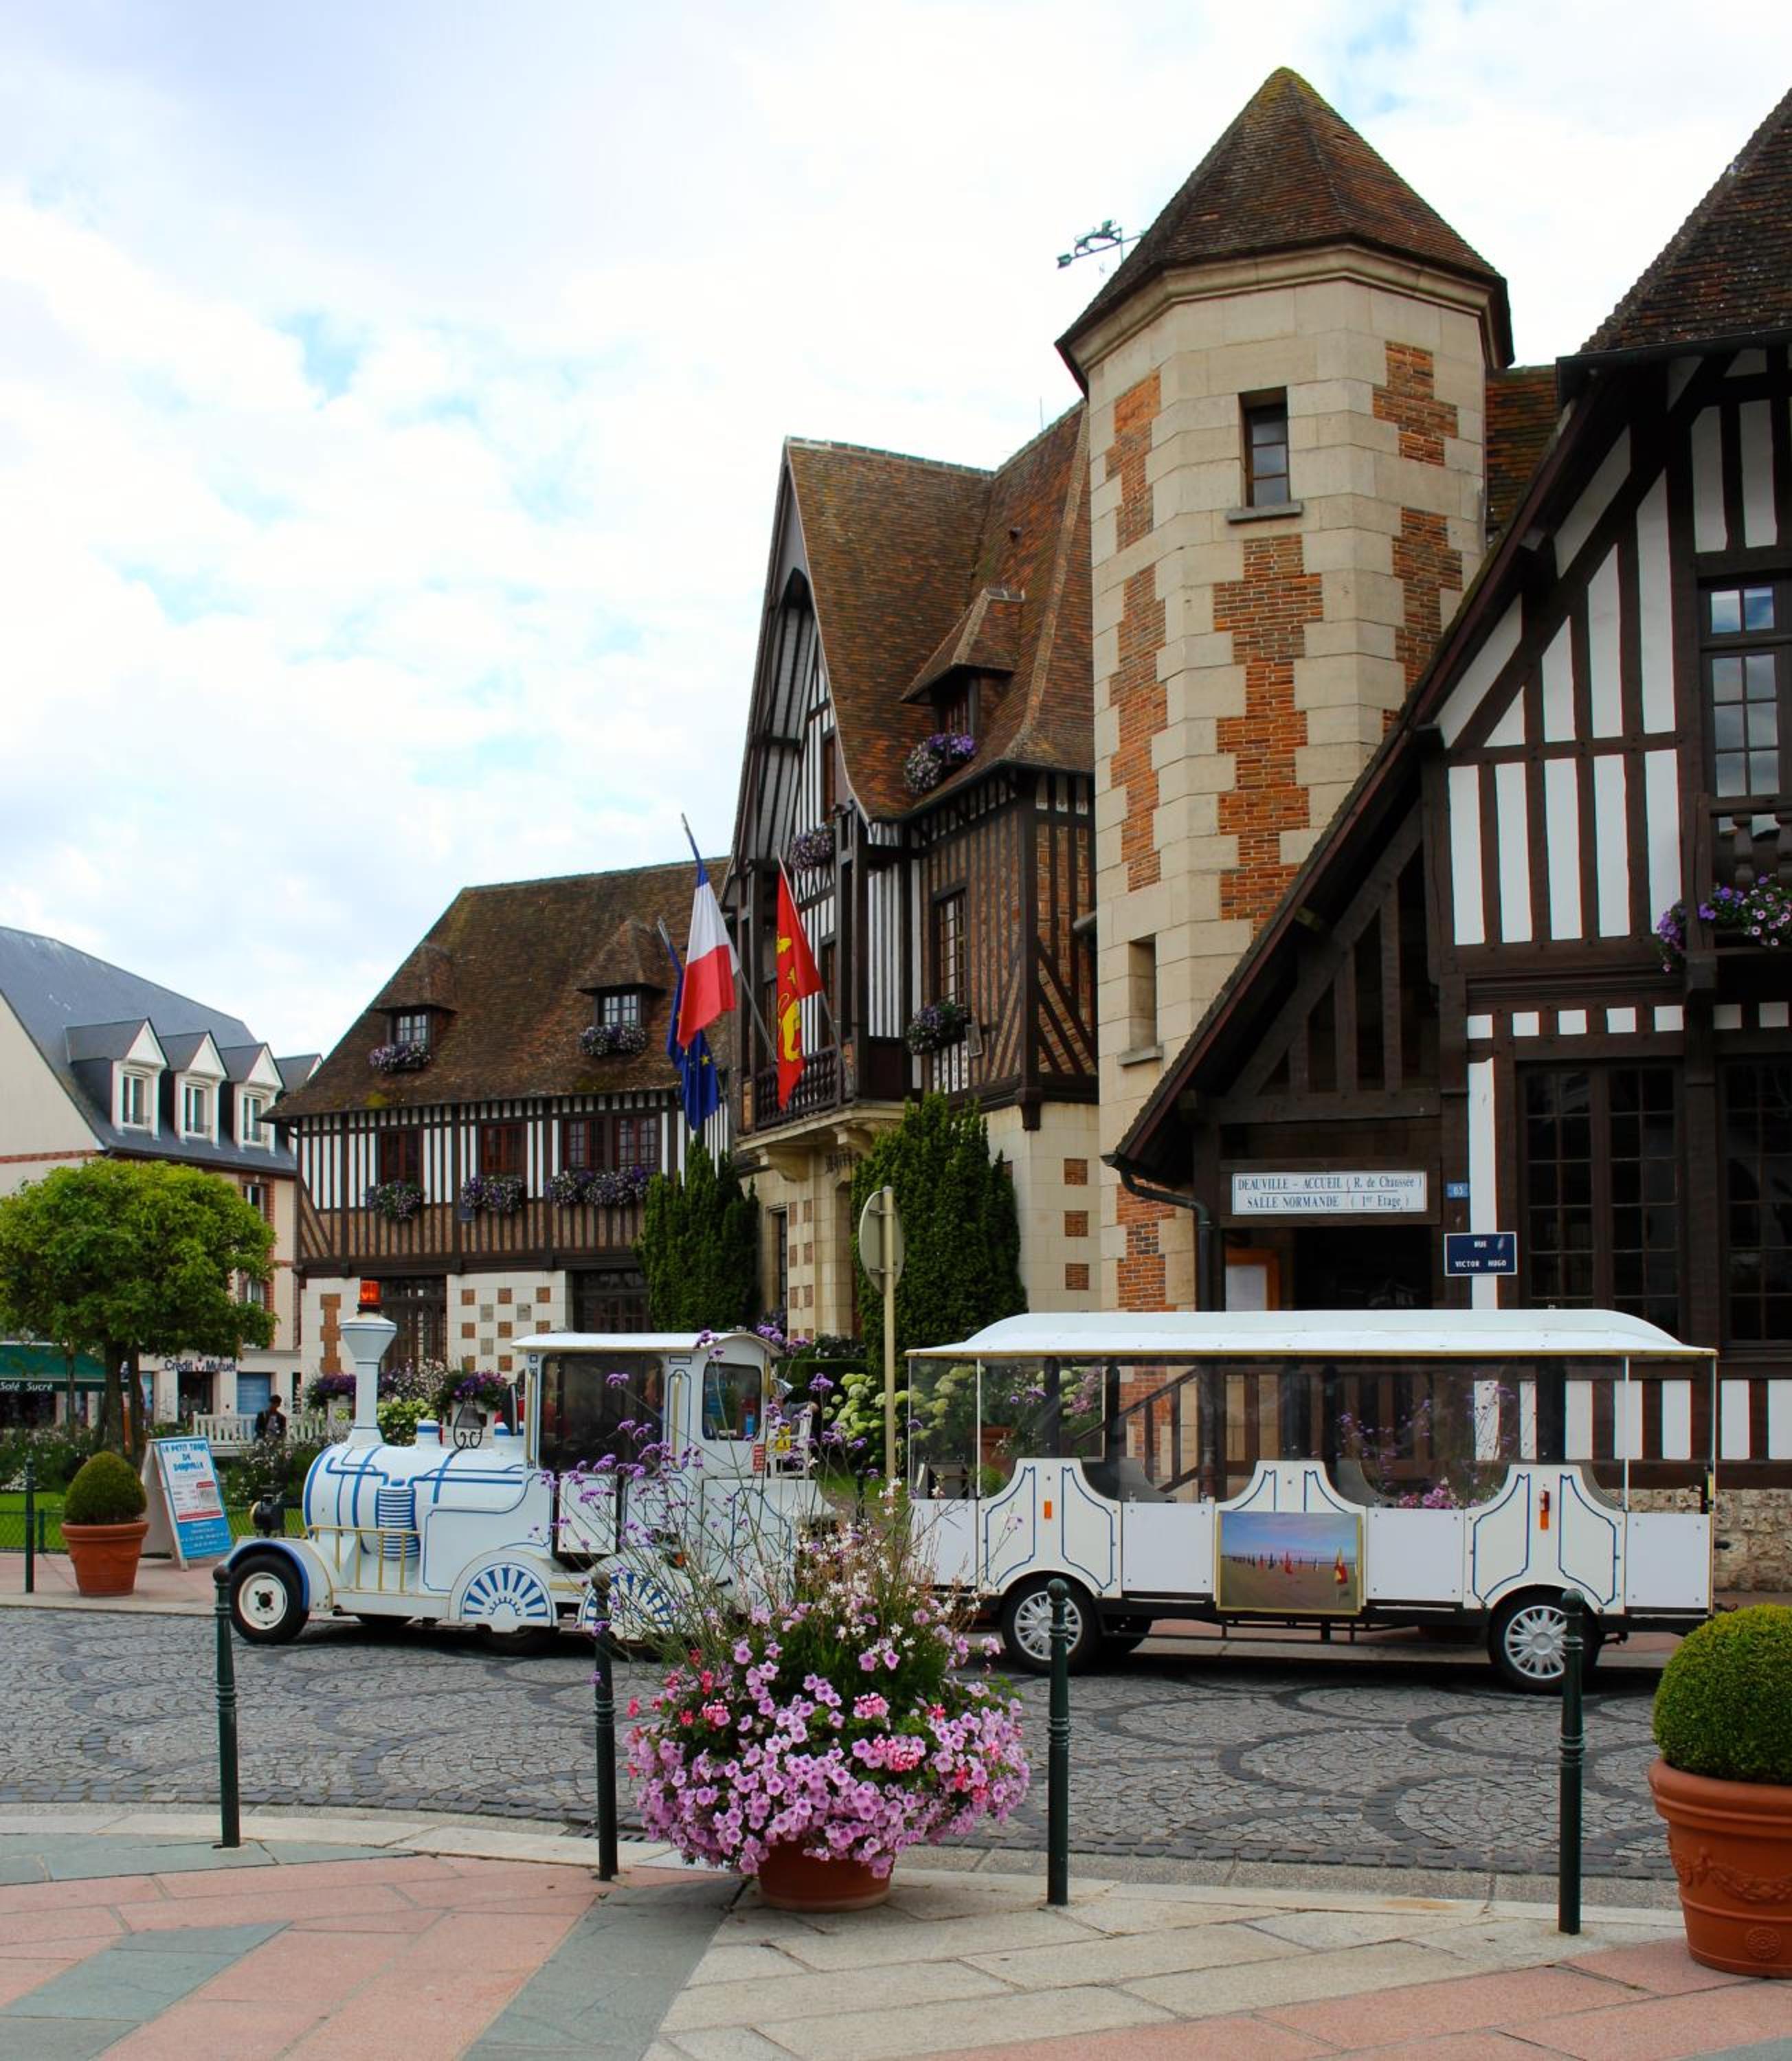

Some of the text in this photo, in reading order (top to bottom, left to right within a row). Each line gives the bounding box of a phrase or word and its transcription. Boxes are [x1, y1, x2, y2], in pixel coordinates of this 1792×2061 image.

[1237, 1178, 1288, 1191] DEAUVILLE
[1305, 1177, 1342, 1189] ACCUEIL
[1367, 1176, 1375, 1188] de
[1247, 1197, 1277, 1208] SALLE
[1283, 1195, 1339, 1208] NORMANDE
[1474, 1240, 1487, 1248] RUE
[26, 1381, 53, 1392] Sucré
